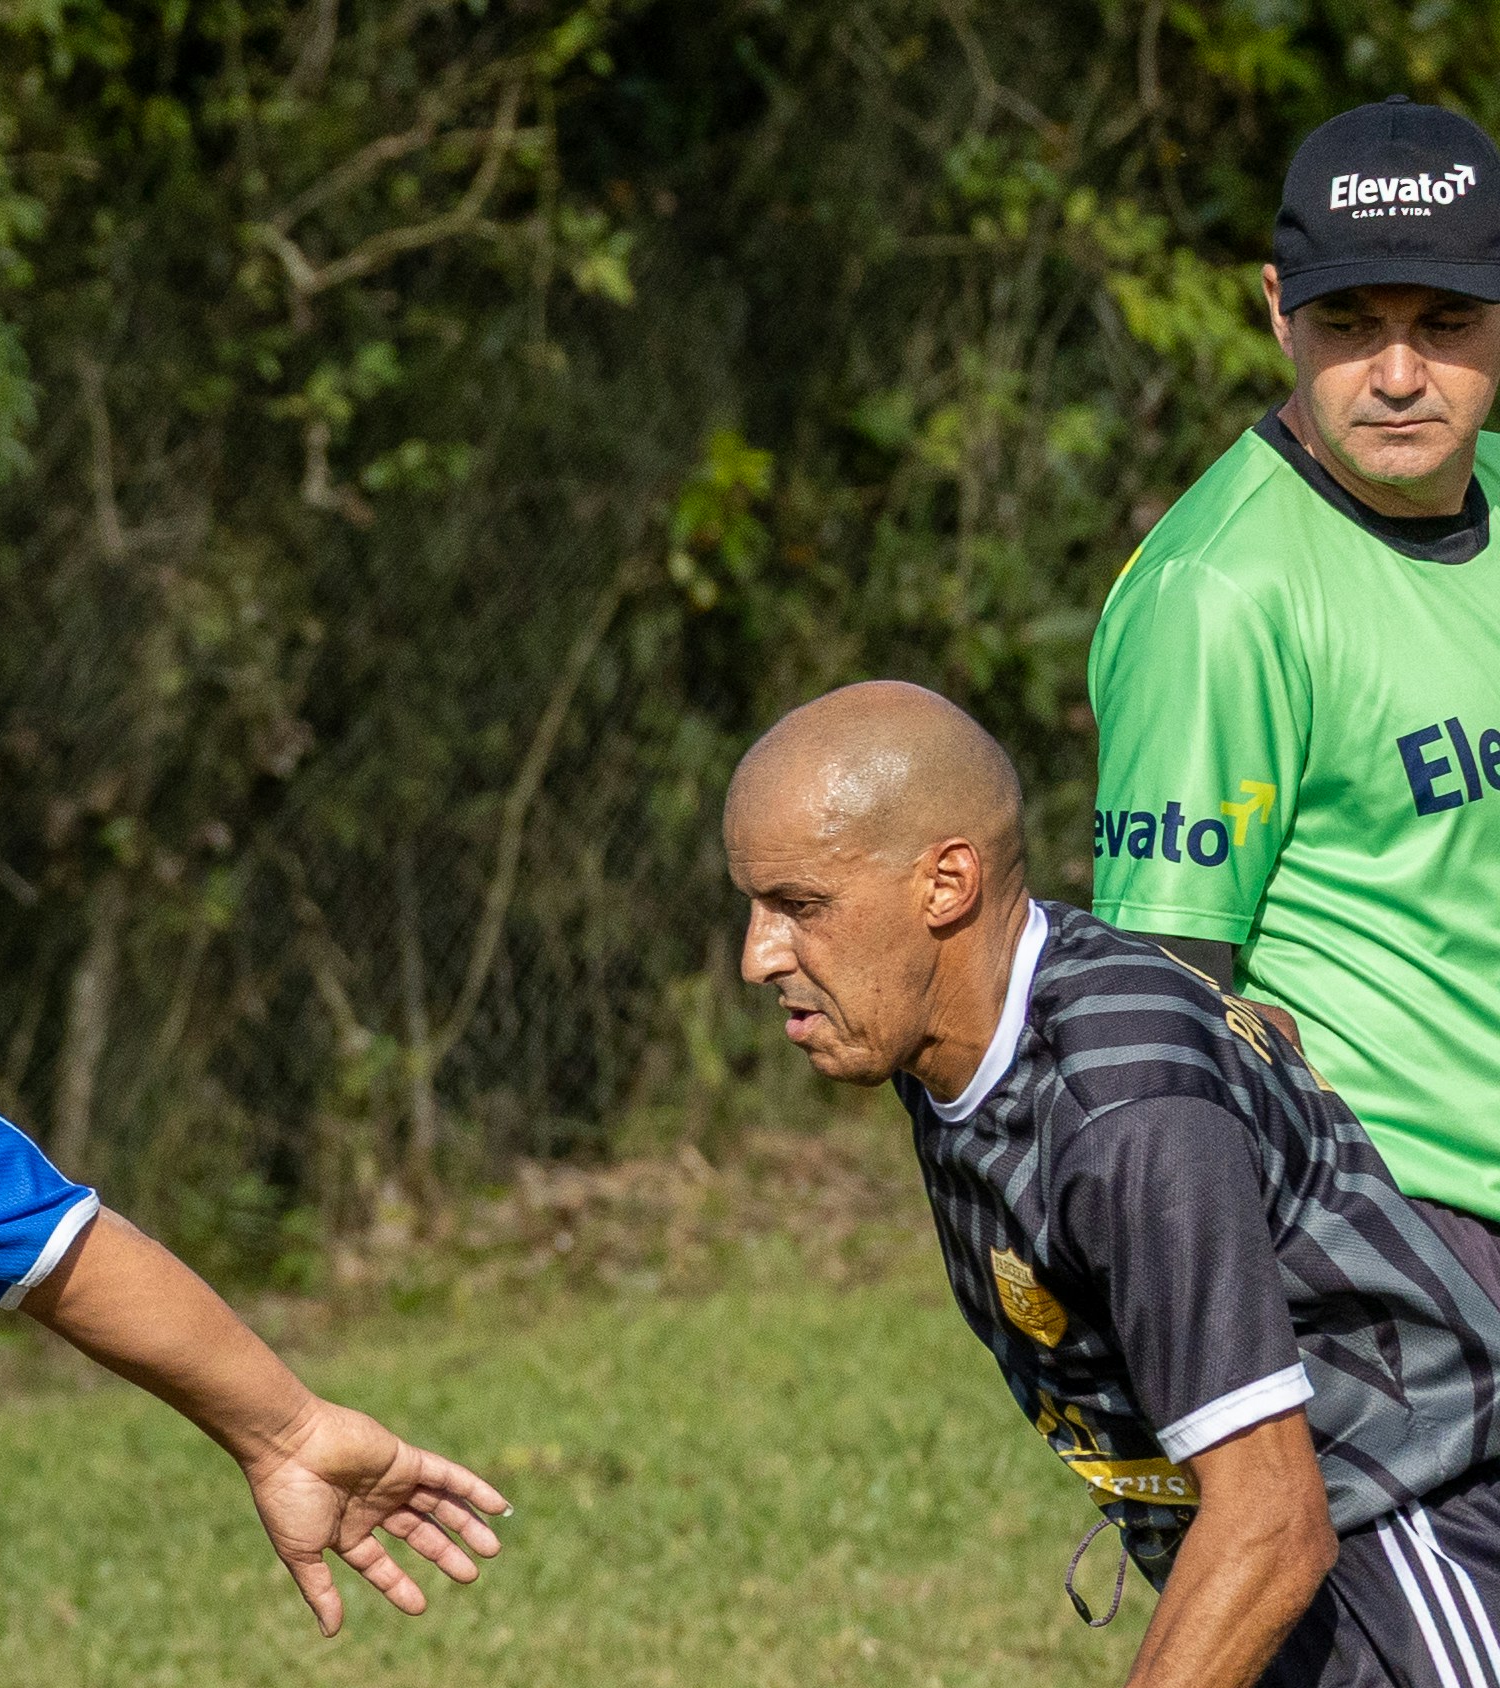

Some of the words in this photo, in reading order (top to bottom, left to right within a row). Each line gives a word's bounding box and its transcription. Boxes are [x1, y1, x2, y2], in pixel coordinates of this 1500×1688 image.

[1330, 172, 1455, 210] Elevato
[1351, 208, 1385, 219] CASA
[1388, 206, 1397, 217] É
[1400, 207, 1432, 217] VIDA
[1395, 716, 1500, 817] Ele
